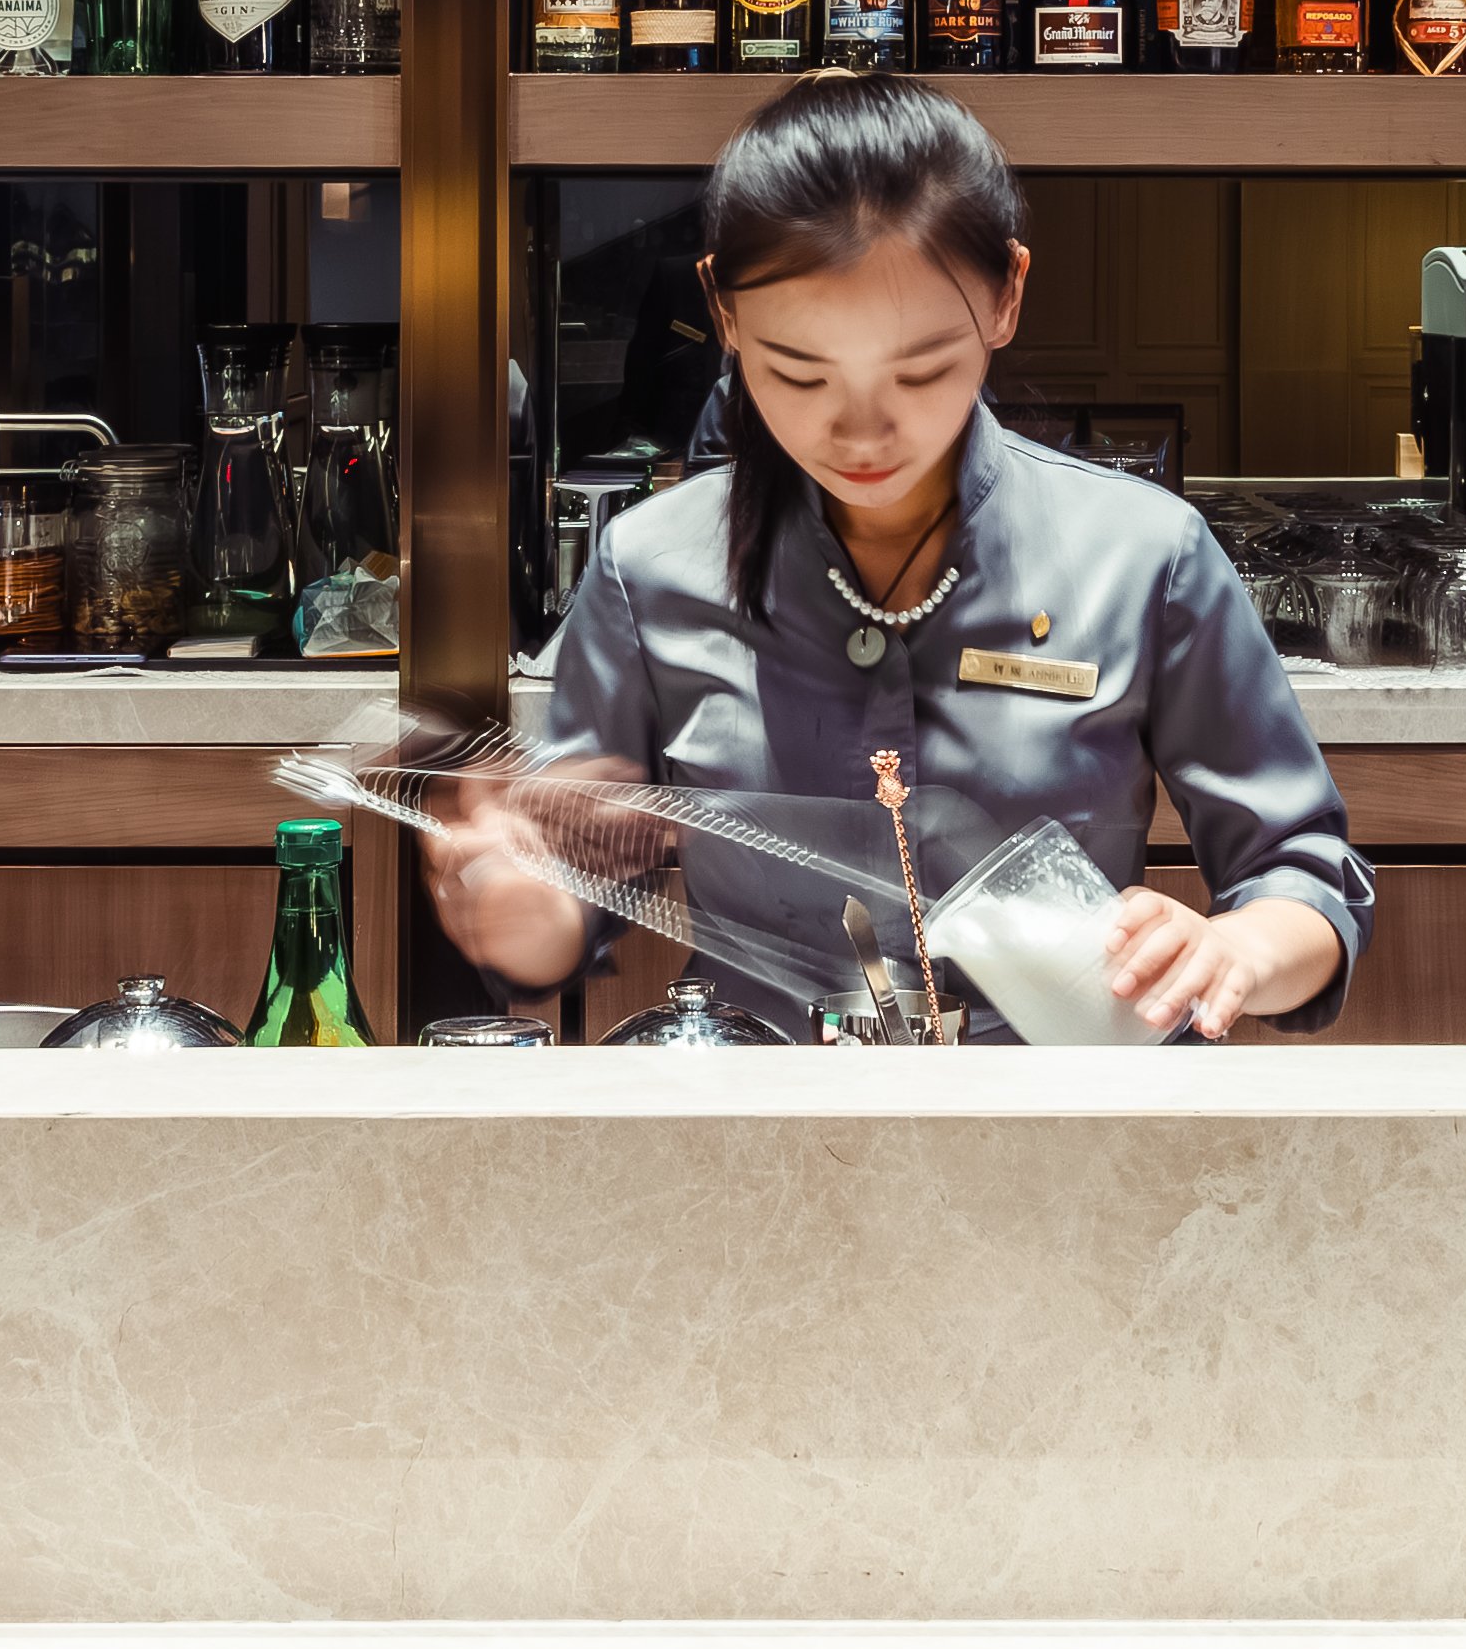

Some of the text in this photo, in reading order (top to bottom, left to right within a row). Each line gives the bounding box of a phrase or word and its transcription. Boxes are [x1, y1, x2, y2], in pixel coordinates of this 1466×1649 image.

[220, 5, 249, 15] GIN
[838, 16, 899, 27] WHITE RUM
[934, 15, 993, 27] DARK RUM
[1305, 12, 1352, 21] REPOSADO
[1043, 25, 1115, 41] Grand Marnier
[1427, 26, 1447, 34] AGED
[1449, 25, 1460, 39] 5
